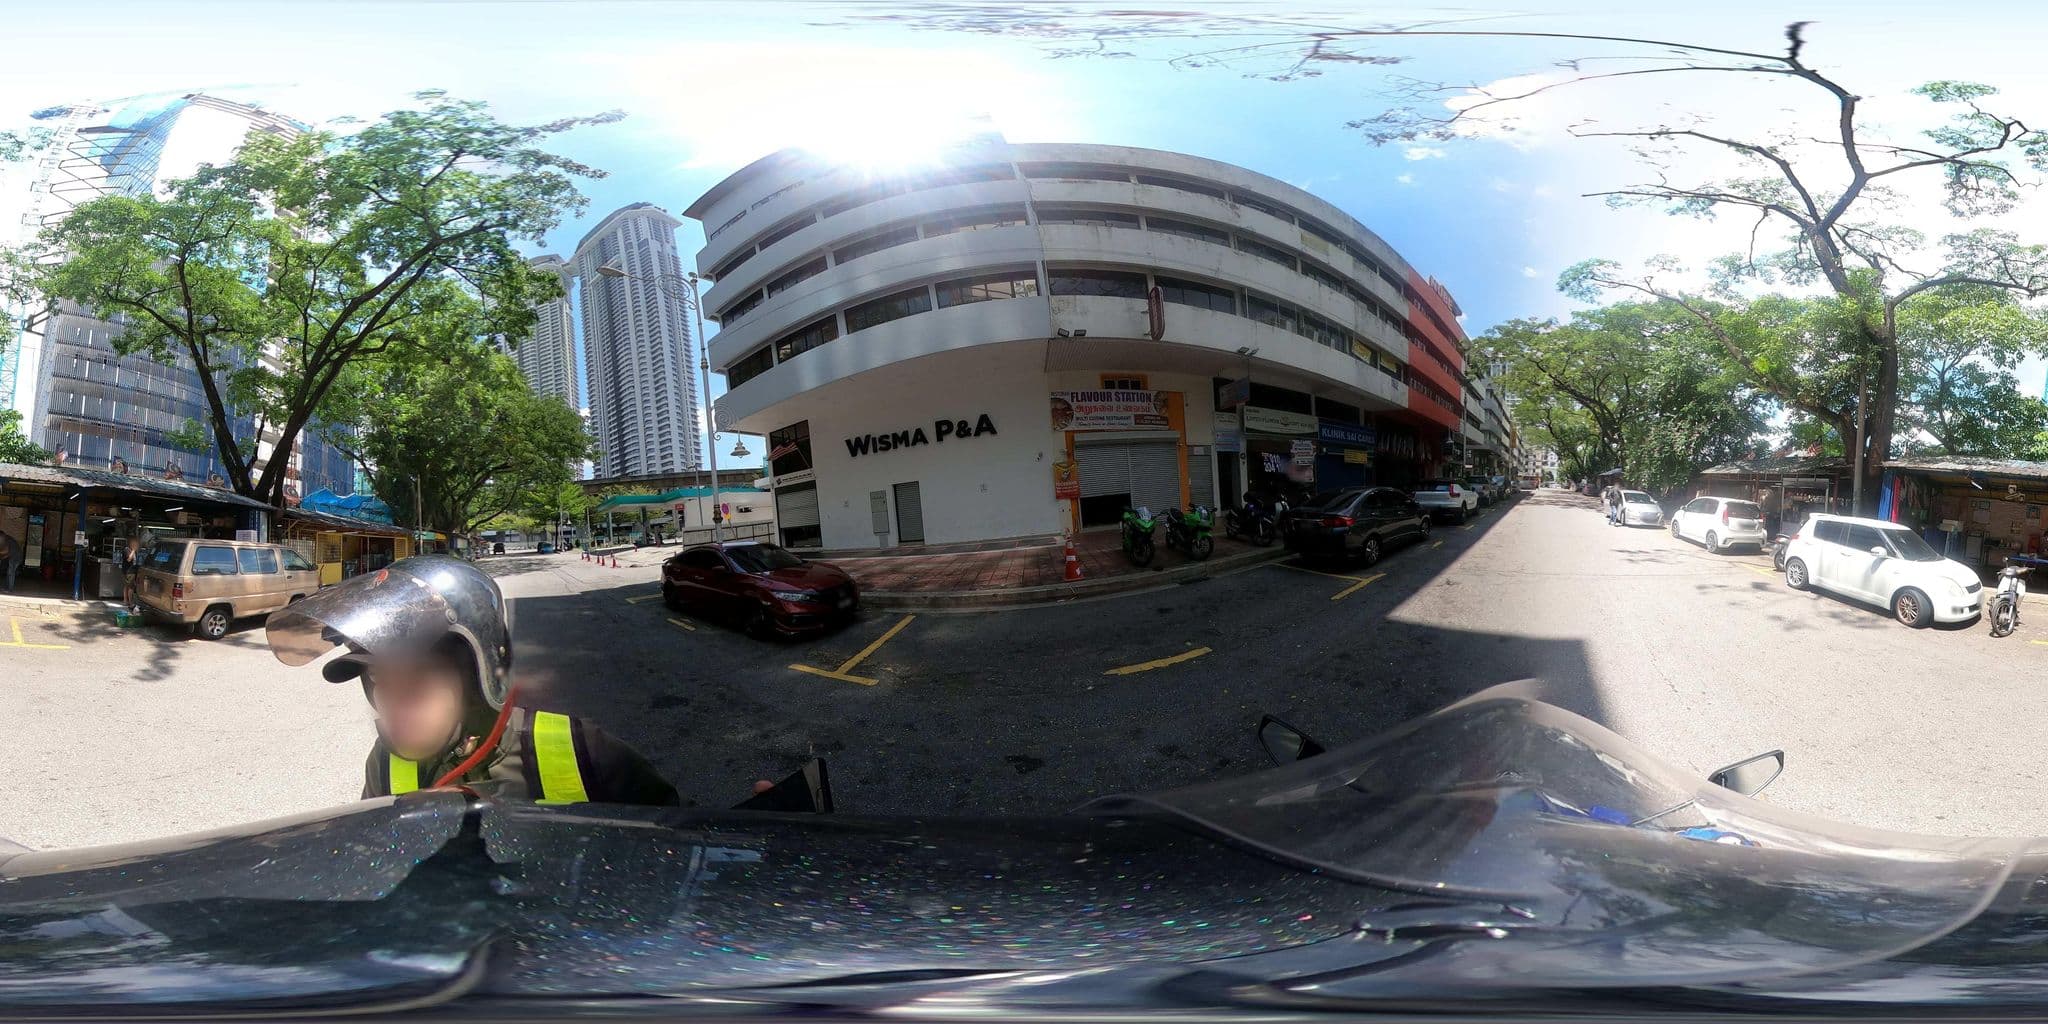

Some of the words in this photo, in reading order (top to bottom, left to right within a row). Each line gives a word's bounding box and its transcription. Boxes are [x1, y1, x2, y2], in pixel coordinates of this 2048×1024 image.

[1070, 391, 1113, 403] FLAVOUR
[1114, 391, 1152, 404] STATION
[934, 413, 997, 442] P&A
[1321, 427, 1346, 440] KLINIK
